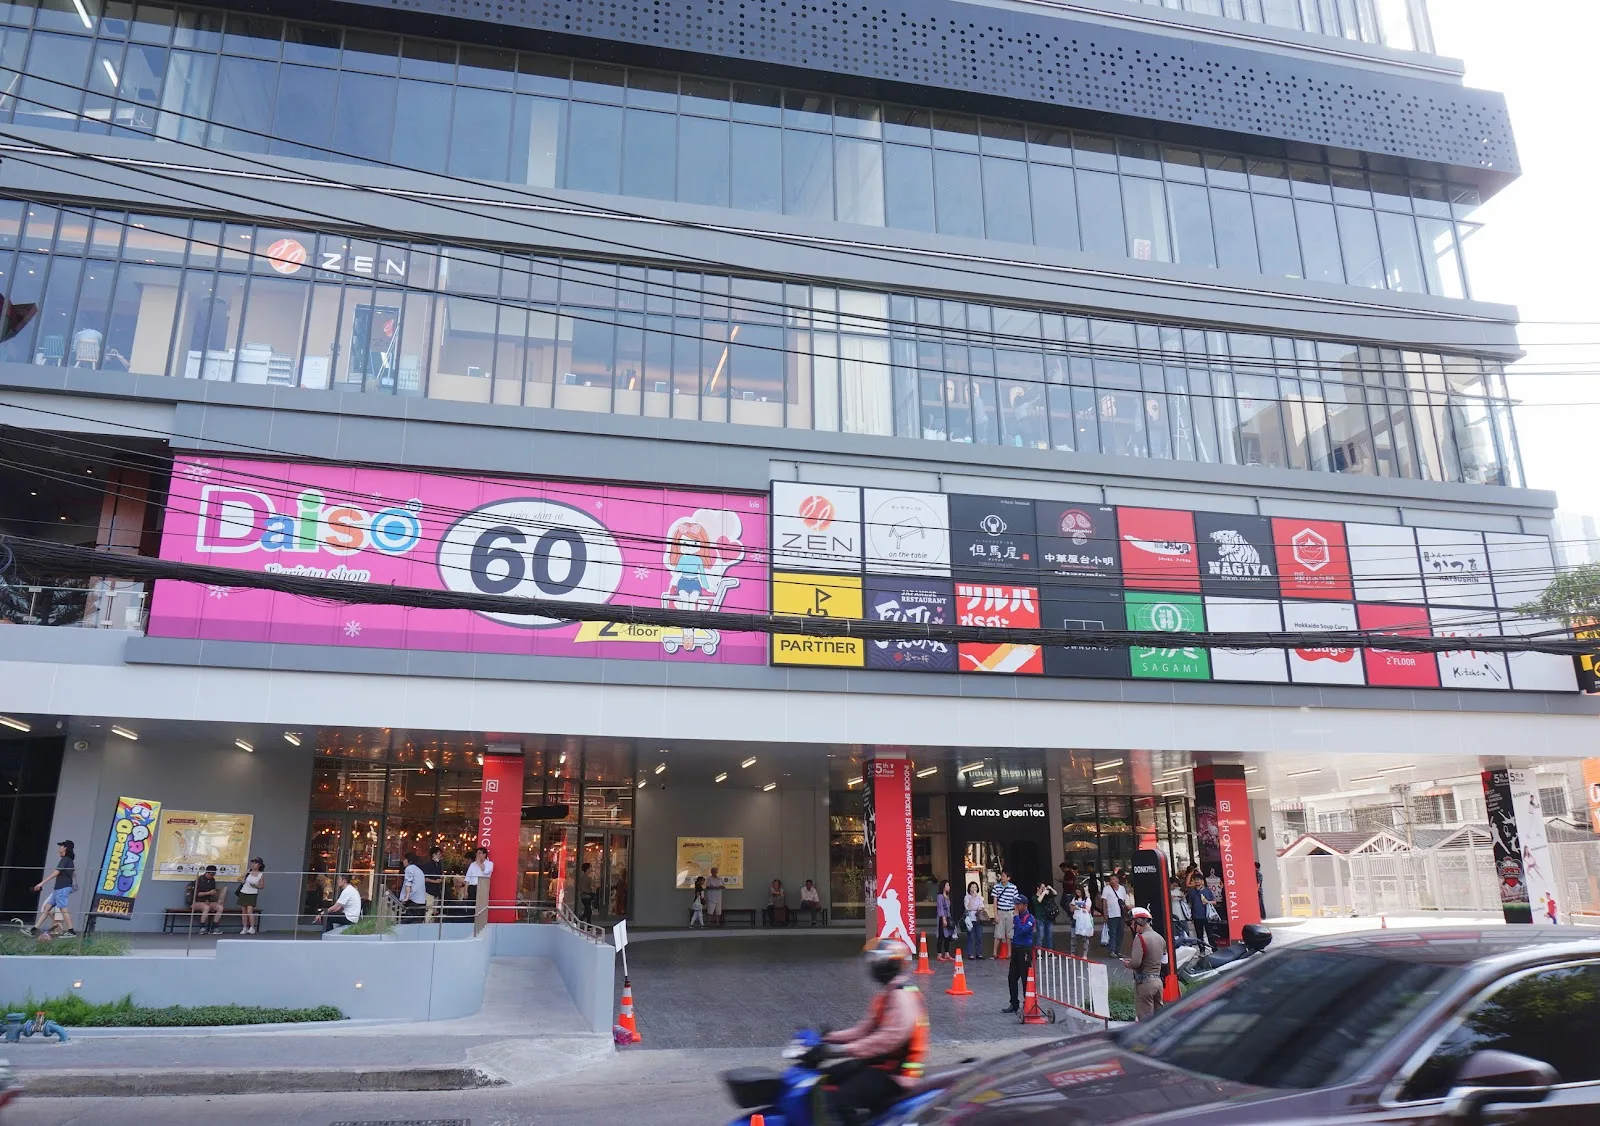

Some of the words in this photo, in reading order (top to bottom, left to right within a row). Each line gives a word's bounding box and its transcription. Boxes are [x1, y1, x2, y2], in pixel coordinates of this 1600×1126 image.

[322, 252, 405, 276] ZEN
[197, 484, 421, 555] Daiso
[782, 533, 853, 552] ZEN
[969, 543, 1020, 560] 但馬屋
[470, 525, 587, 595] 60
[1208, 561, 1272, 576] NAGIYA
[901, 596, 947, 604] RESTAURANT
[958, 586, 1035, 614] ツルハ
[628, 625, 658, 636] floor
[780, 639, 856, 654] PARTNER
[1142, 662, 1198, 673] SAGAMI
[1394, 657, 1416, 666] FLOOR
[970, 808, 1001, 817] nana's
[1002, 807, 1029, 819] green
[1029, 807, 1046, 817] tea
[103, 818, 133, 891] OPENING
[117, 825, 149, 892] GRAND
[904, 793, 912, 817] SPORTS
[908, 904, 914, 912] IN
[1221, 818, 1236, 886] THONGLOR
[97, 904, 129, 915] DONKI
[1228, 891, 1240, 920] HALL
